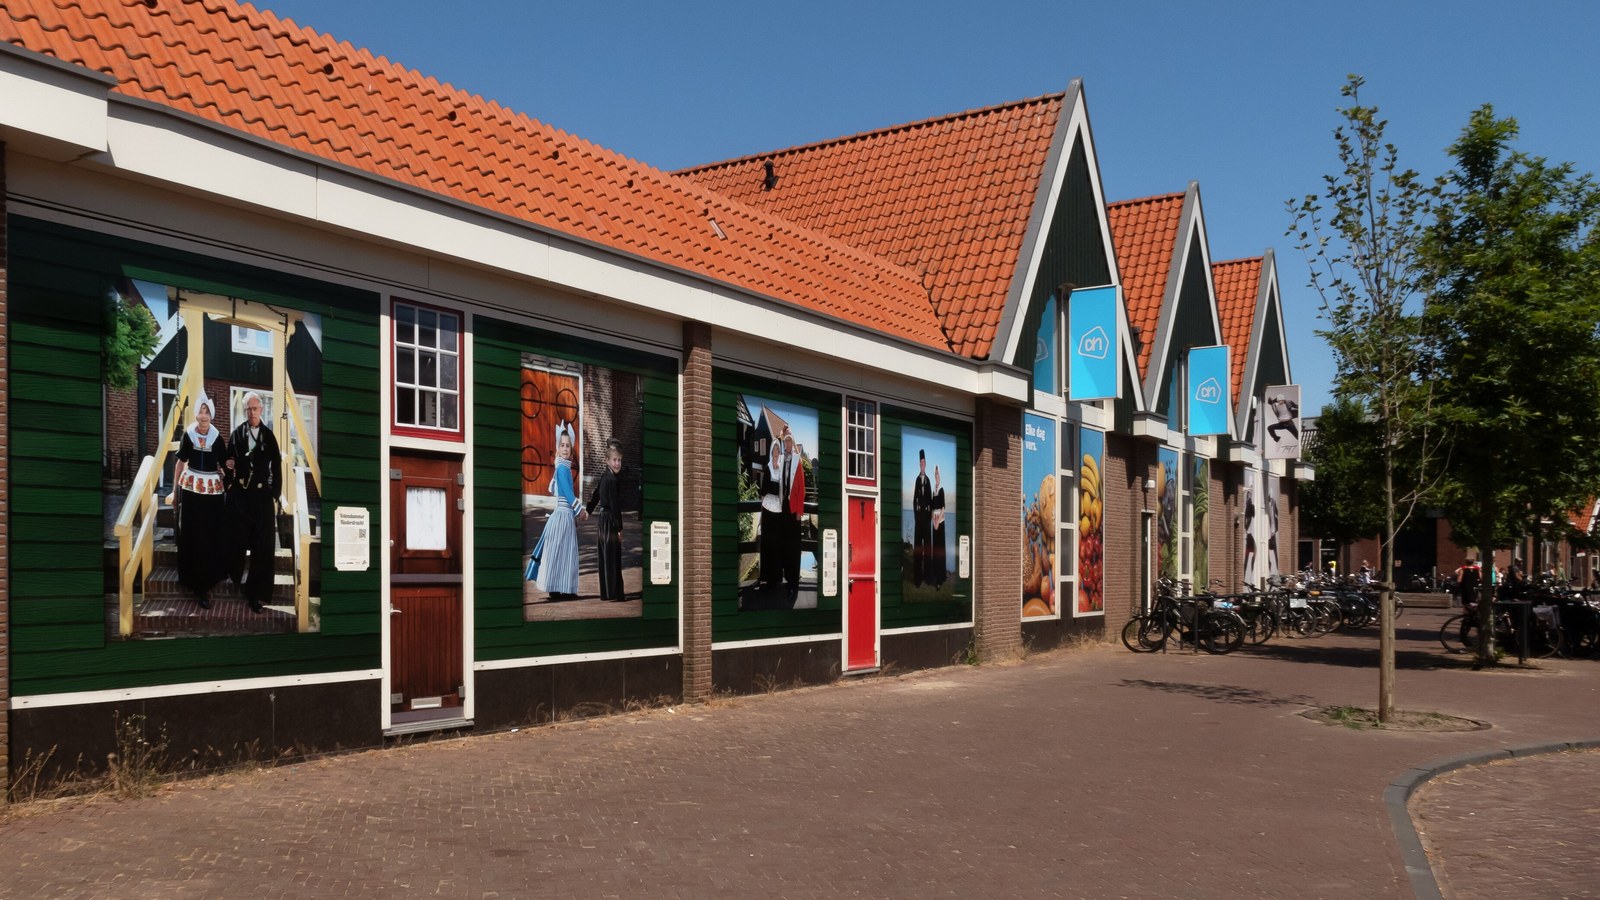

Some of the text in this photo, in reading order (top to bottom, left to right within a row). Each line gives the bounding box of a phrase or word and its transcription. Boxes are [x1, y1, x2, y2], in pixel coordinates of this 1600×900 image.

[1025, 423, 1046, 442] Elke dag
[1025, 440, 1038, 451] vers.
